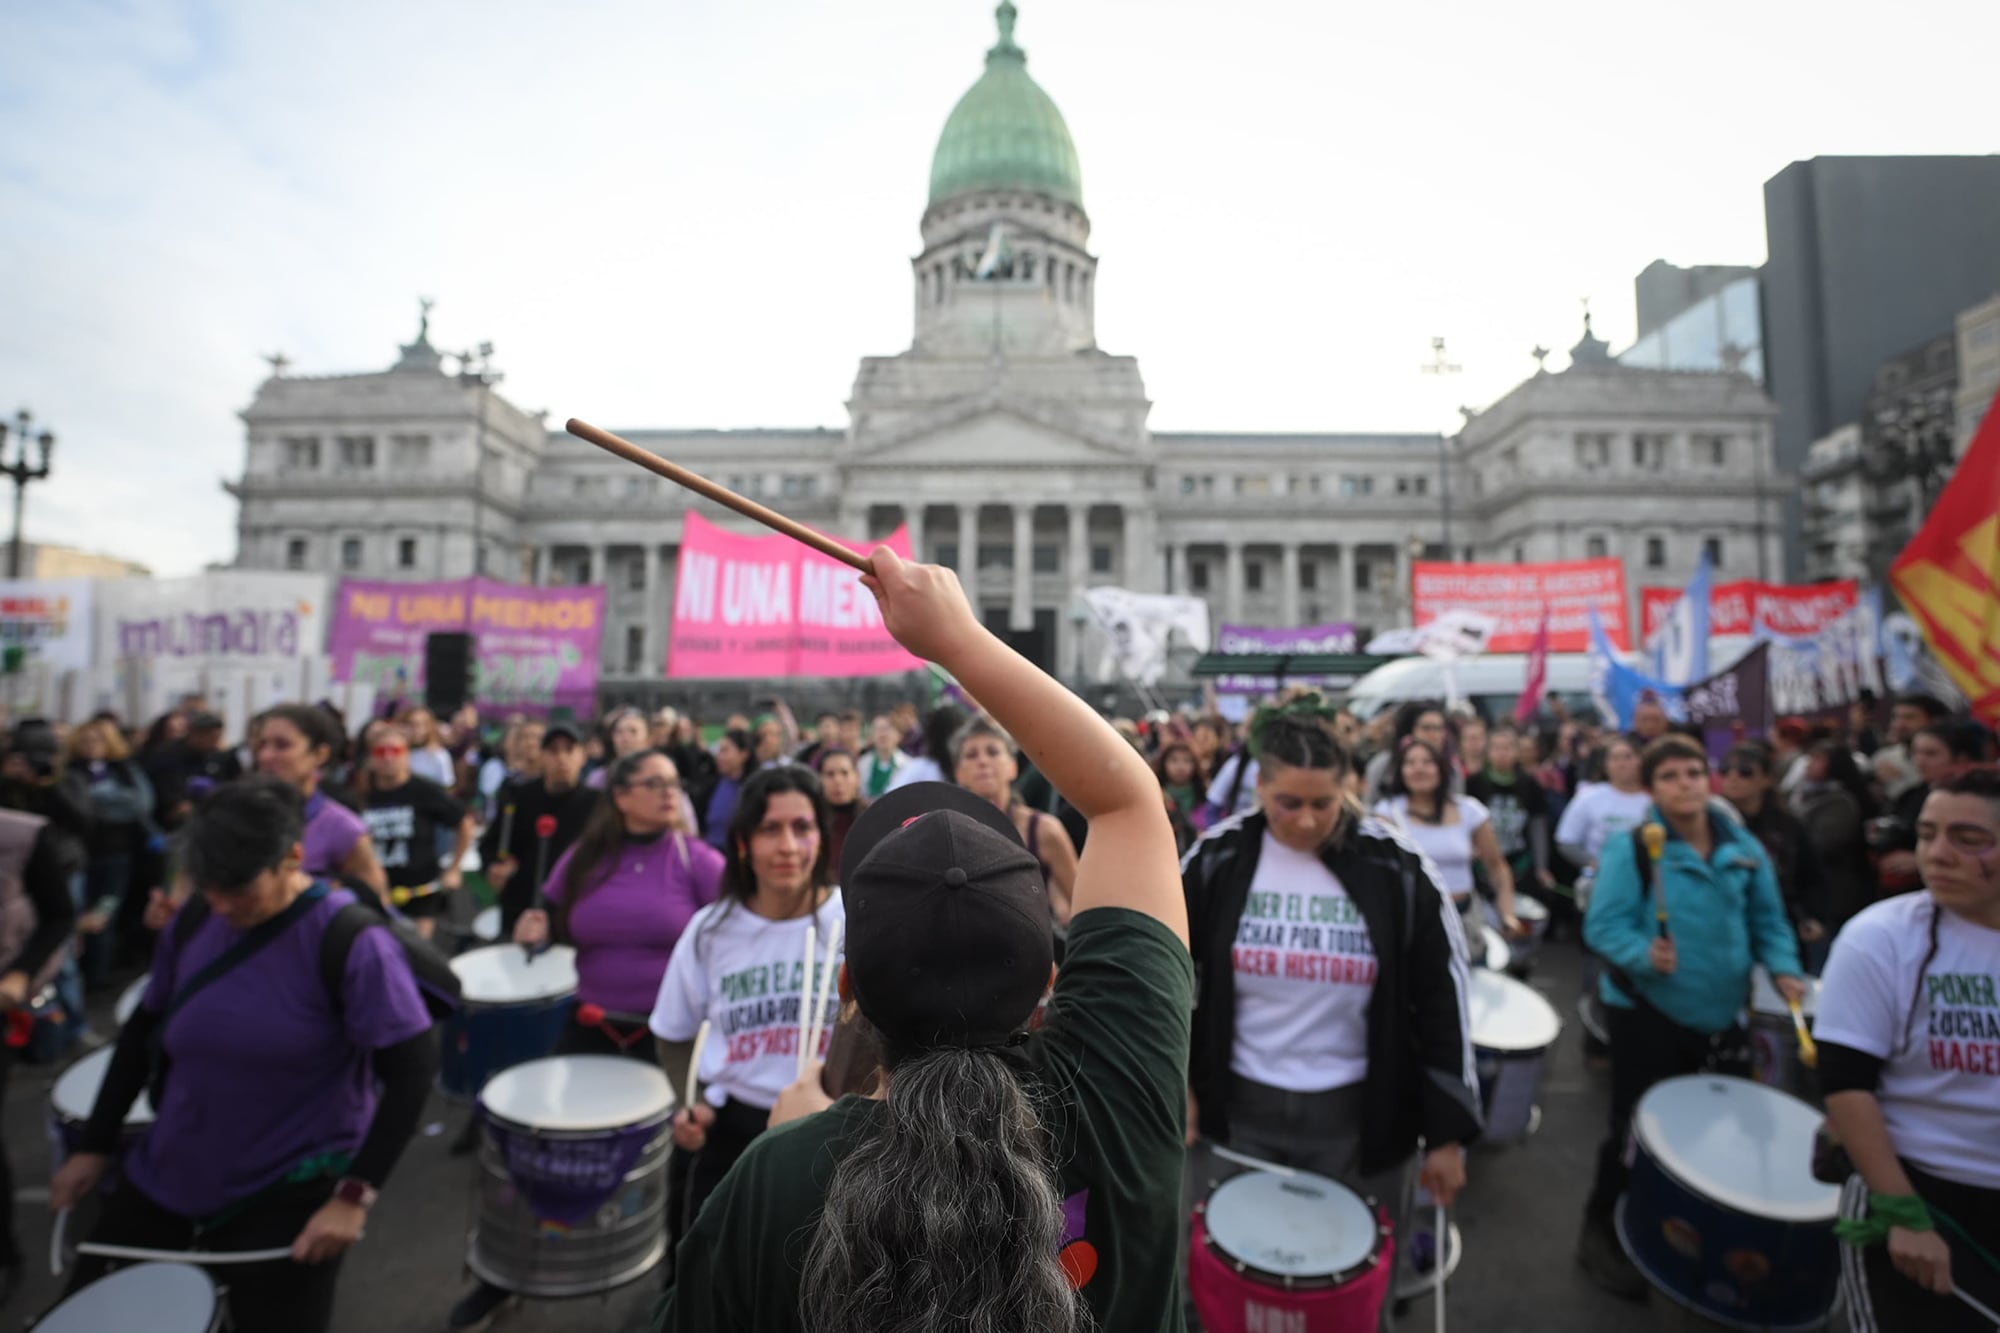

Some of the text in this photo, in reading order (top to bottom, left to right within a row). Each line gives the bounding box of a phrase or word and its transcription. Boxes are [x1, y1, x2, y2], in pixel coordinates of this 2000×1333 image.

[677, 552, 882, 629] NI UNA MEN
[351, 591, 596, 630] NI UNA MENOS
[1247, 891, 1360, 925] NER EL CUER
[1238, 920, 1285, 947] CHAR
[1289, 924, 1322, 950] POR
[1232, 948, 1377, 985] ACER HISTORIA
[1927, 973, 1999, 1008] PONER
